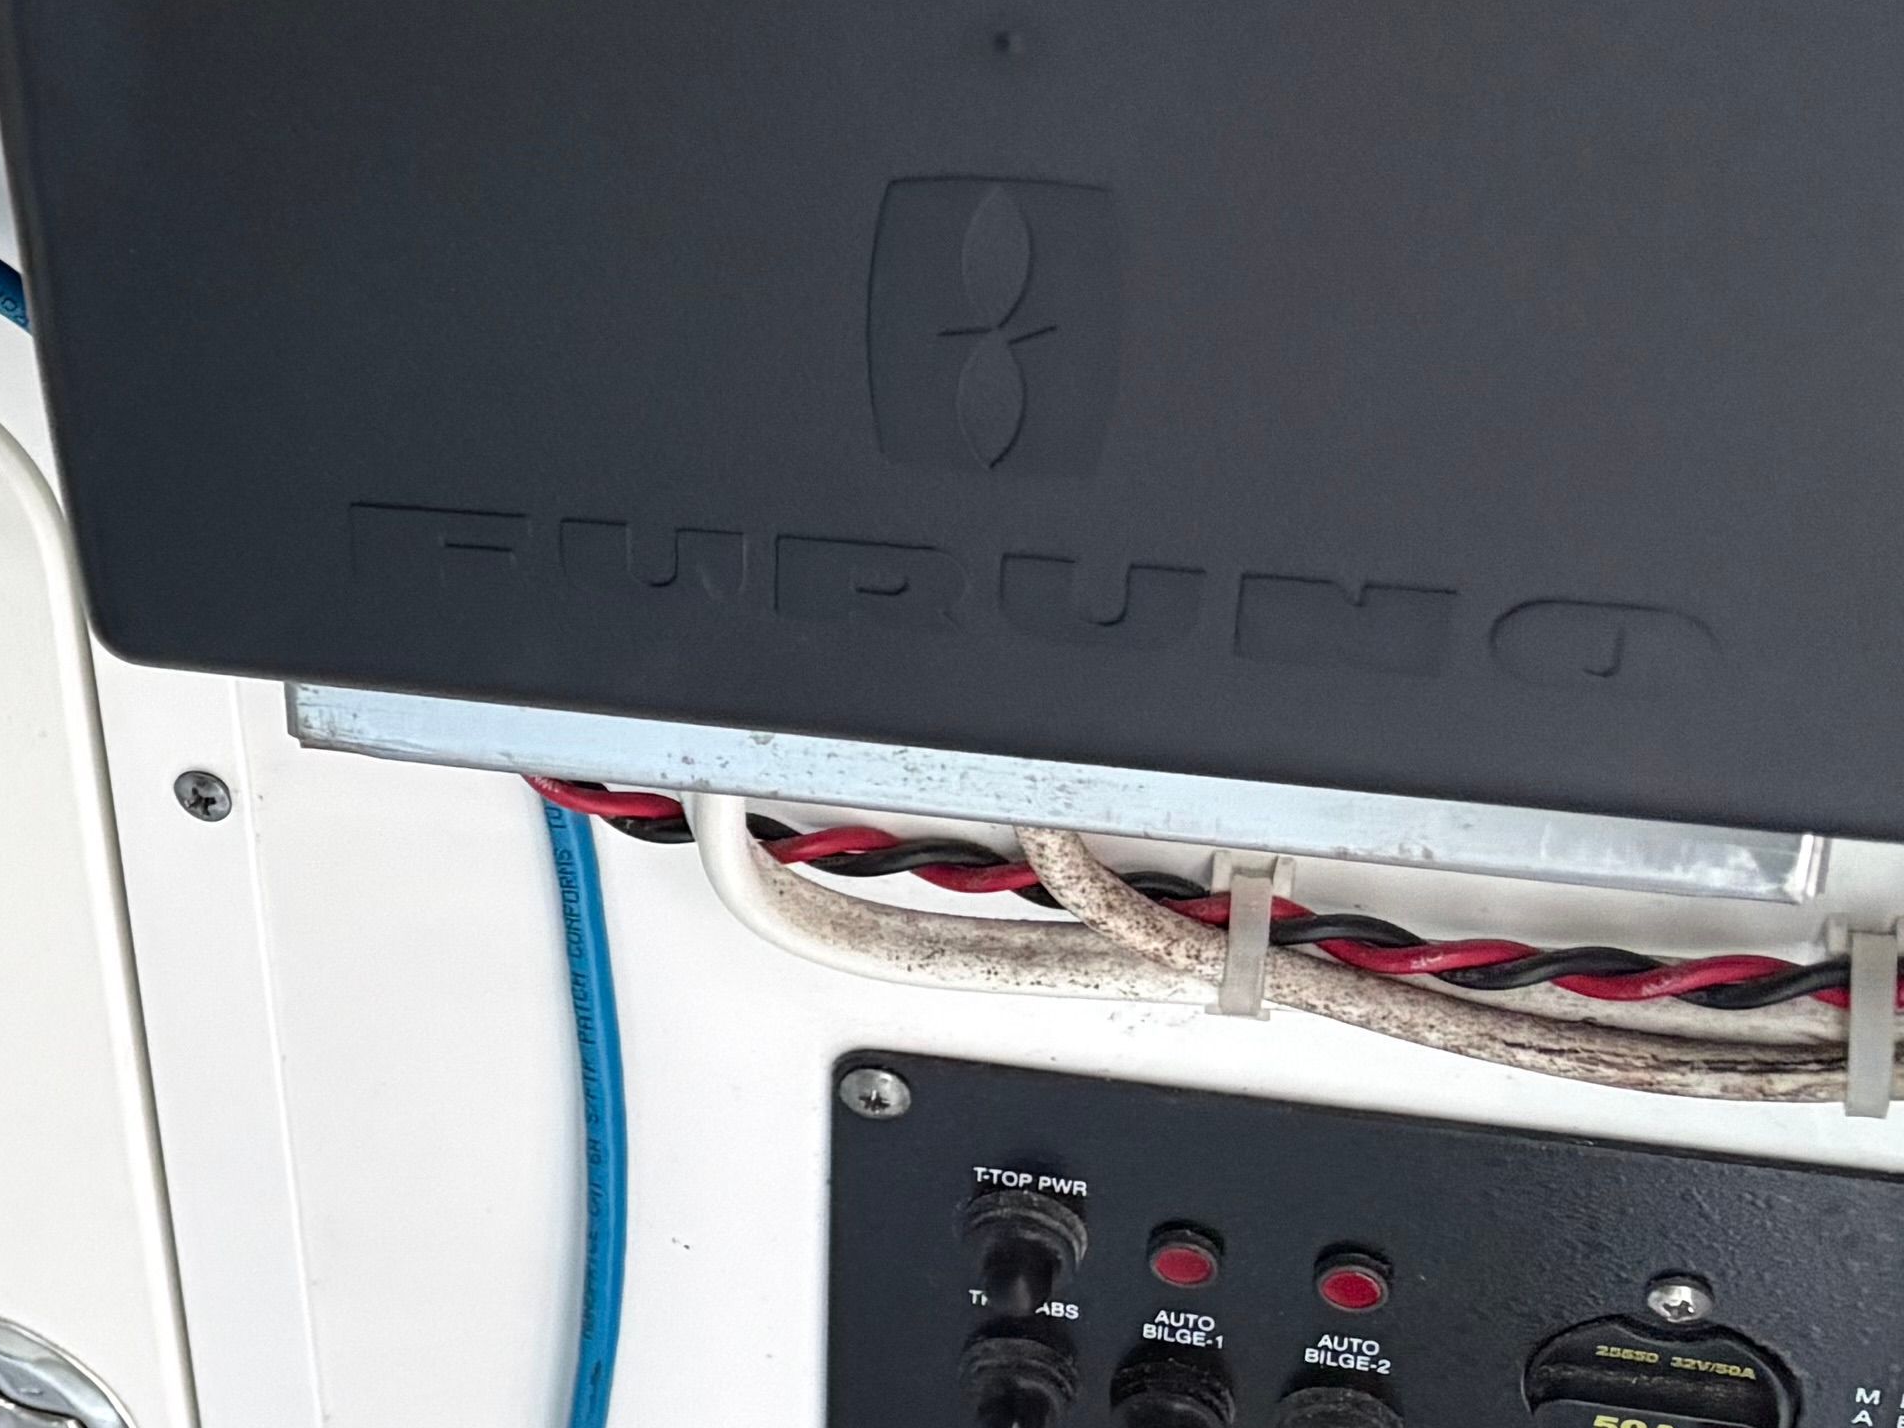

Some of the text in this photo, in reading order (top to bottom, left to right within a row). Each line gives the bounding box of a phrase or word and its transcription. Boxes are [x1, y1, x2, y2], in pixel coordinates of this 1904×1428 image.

[347, 499, 1722, 687] FURUNO
[555, 848, 584, 959] CONFORMS
[972, 1166, 1087, 1197] T-TOP PWR
[1034, 1300, 1080, 1320] ABS
[1154, 1309, 1215, 1332] AUTO
[1142, 1323, 1224, 1349] BILGE-1
[1317, 1334, 1380, 1357] AUTO
[1304, 1347, 1392, 1375] BILGE-2
